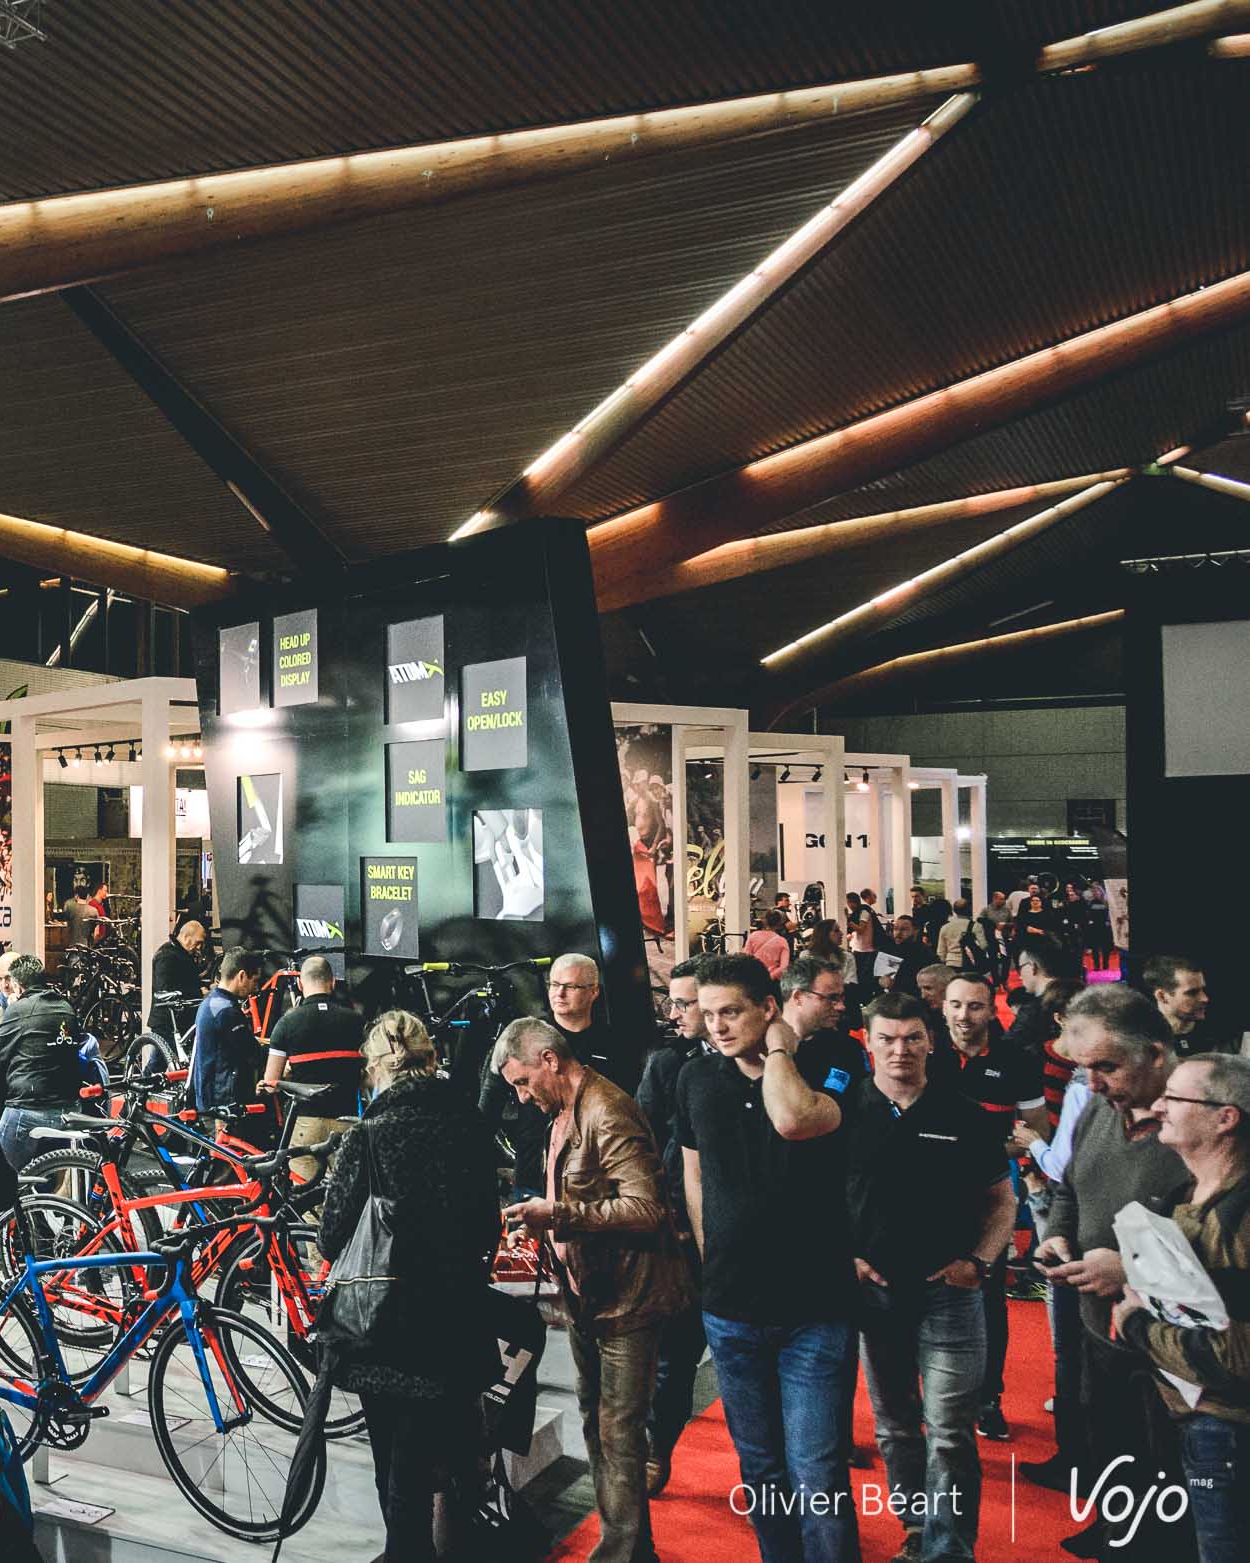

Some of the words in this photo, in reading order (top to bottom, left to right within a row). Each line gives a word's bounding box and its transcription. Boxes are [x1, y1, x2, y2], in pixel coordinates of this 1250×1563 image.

[279, 635, 300, 651] HEAD
[300, 633, 311, 647] UP
[279, 652, 311, 669] COLORED
[280, 670, 311, 688] DISPLAY
[481, 690, 508, 708] EASY
[467, 710, 523, 731] OPEN/LOCK
[408, 769, 427, 786] SAG
[395, 789, 441, 807] INDICATOR
[367, 865, 396, 881] SMART
[398, 865, 415, 881] KEY
[370, 885, 413, 902] BRACELET
